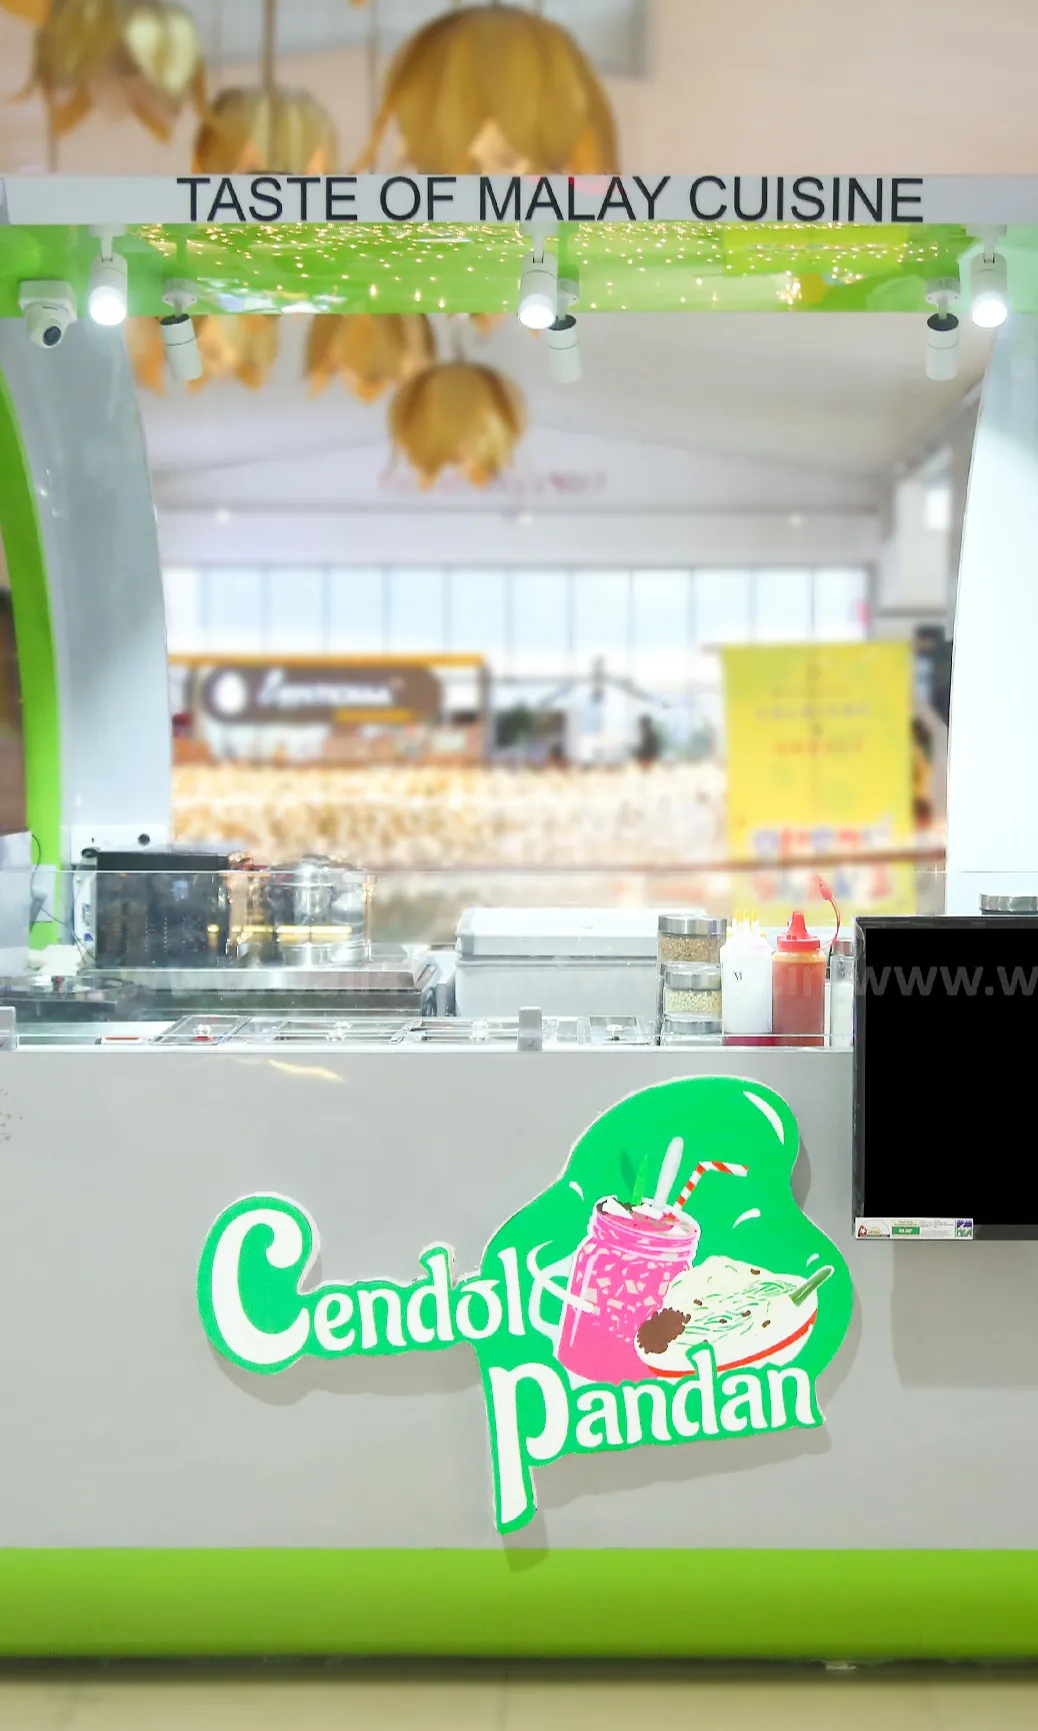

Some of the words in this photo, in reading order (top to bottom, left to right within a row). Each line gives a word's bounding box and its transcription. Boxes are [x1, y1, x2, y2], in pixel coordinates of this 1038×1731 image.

[176, 176, 358, 222] TASTE
[379, 176, 457, 222] OF
[479, 176, 671, 221] MALAY
[689, 175, 924, 222] CUISINE
[211, 1208, 527, 1365] Cendol
[488, 1347, 817, 1525] Pandan
